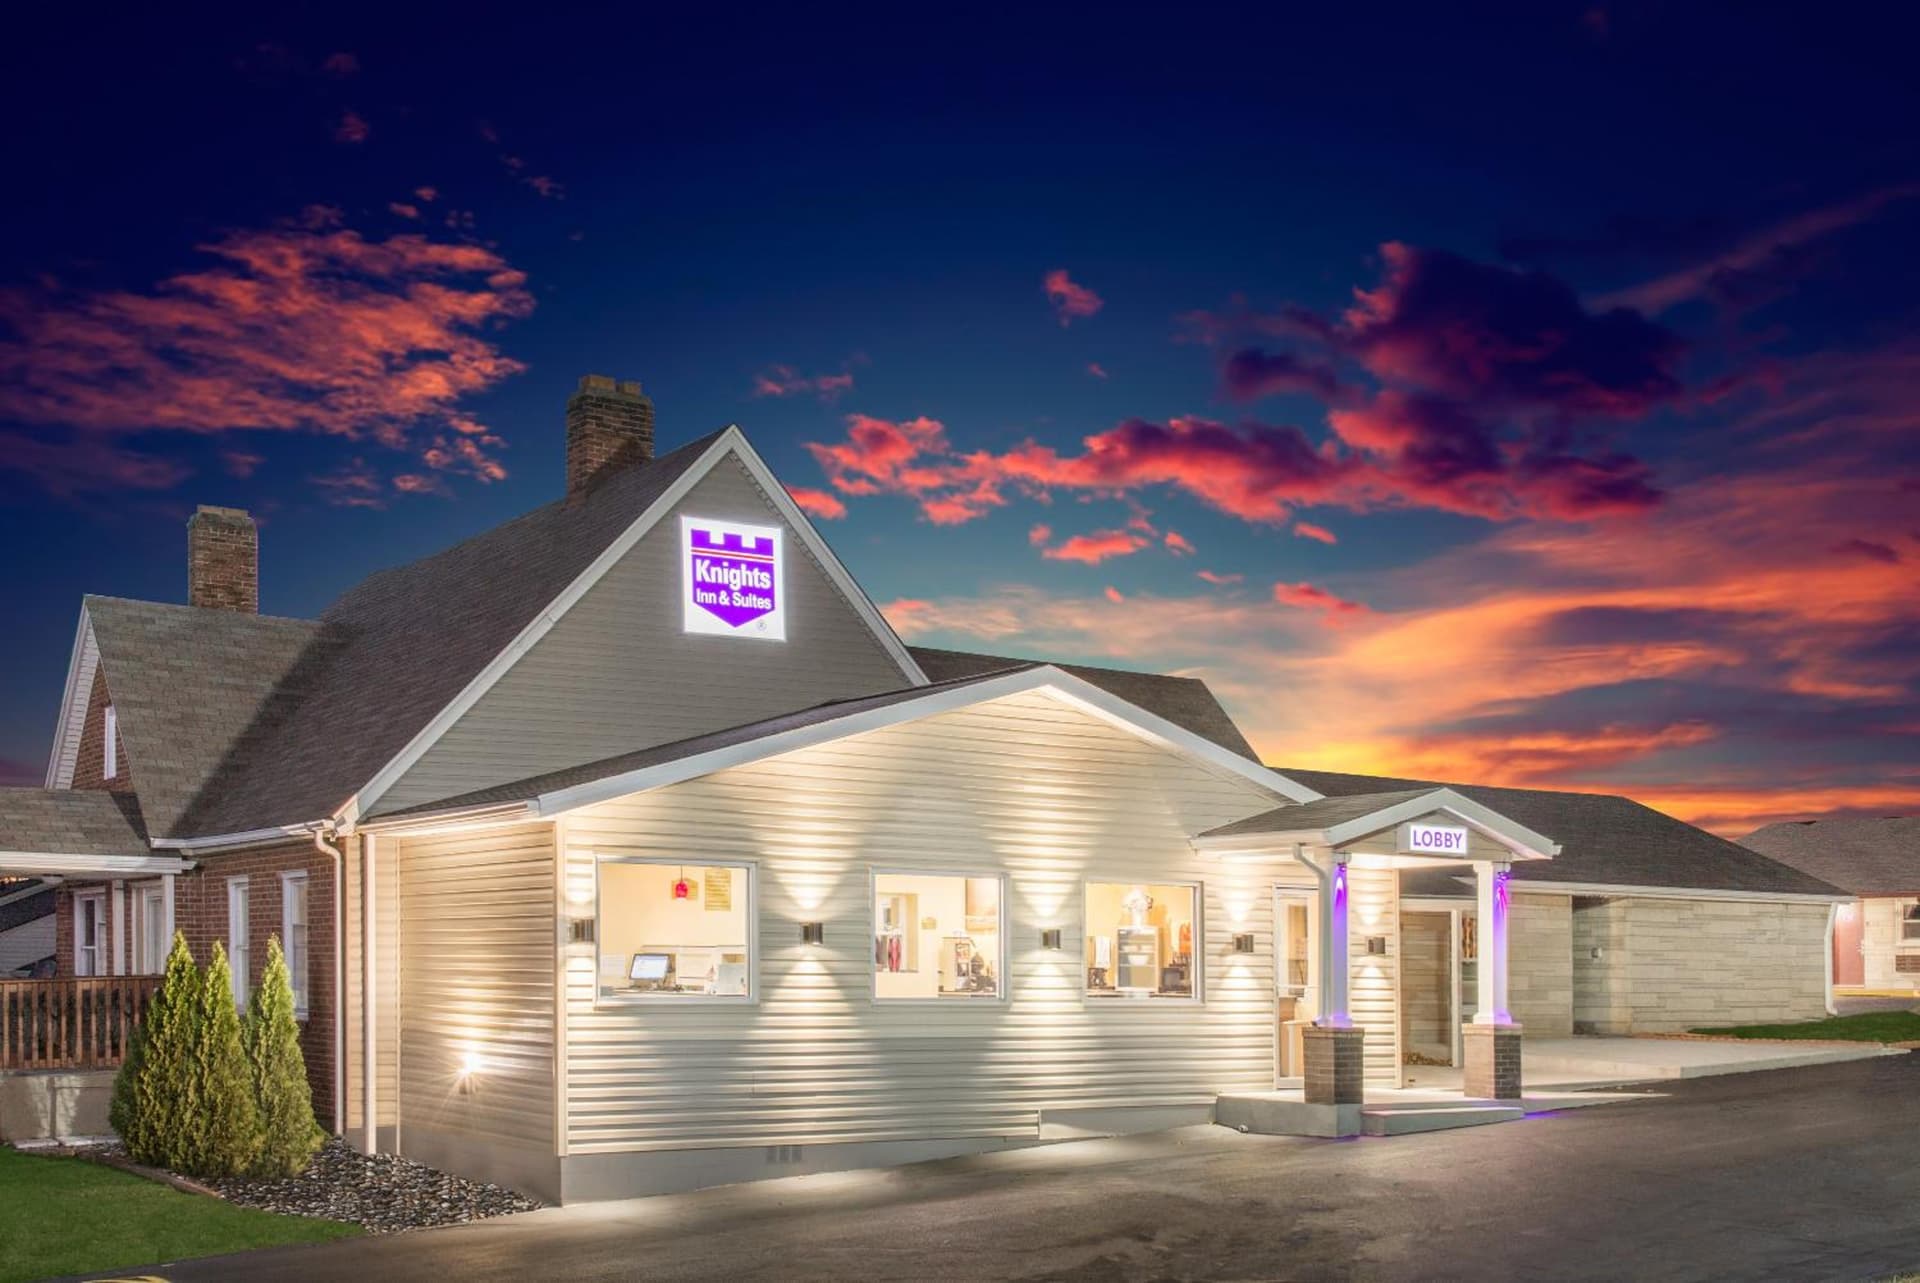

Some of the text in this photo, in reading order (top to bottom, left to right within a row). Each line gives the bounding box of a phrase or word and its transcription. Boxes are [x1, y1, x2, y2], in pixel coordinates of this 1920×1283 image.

[695, 559, 772, 591] Knights
[696, 589, 772, 609] Inn & Suites
[1413, 830, 1462, 849] LOBBY
